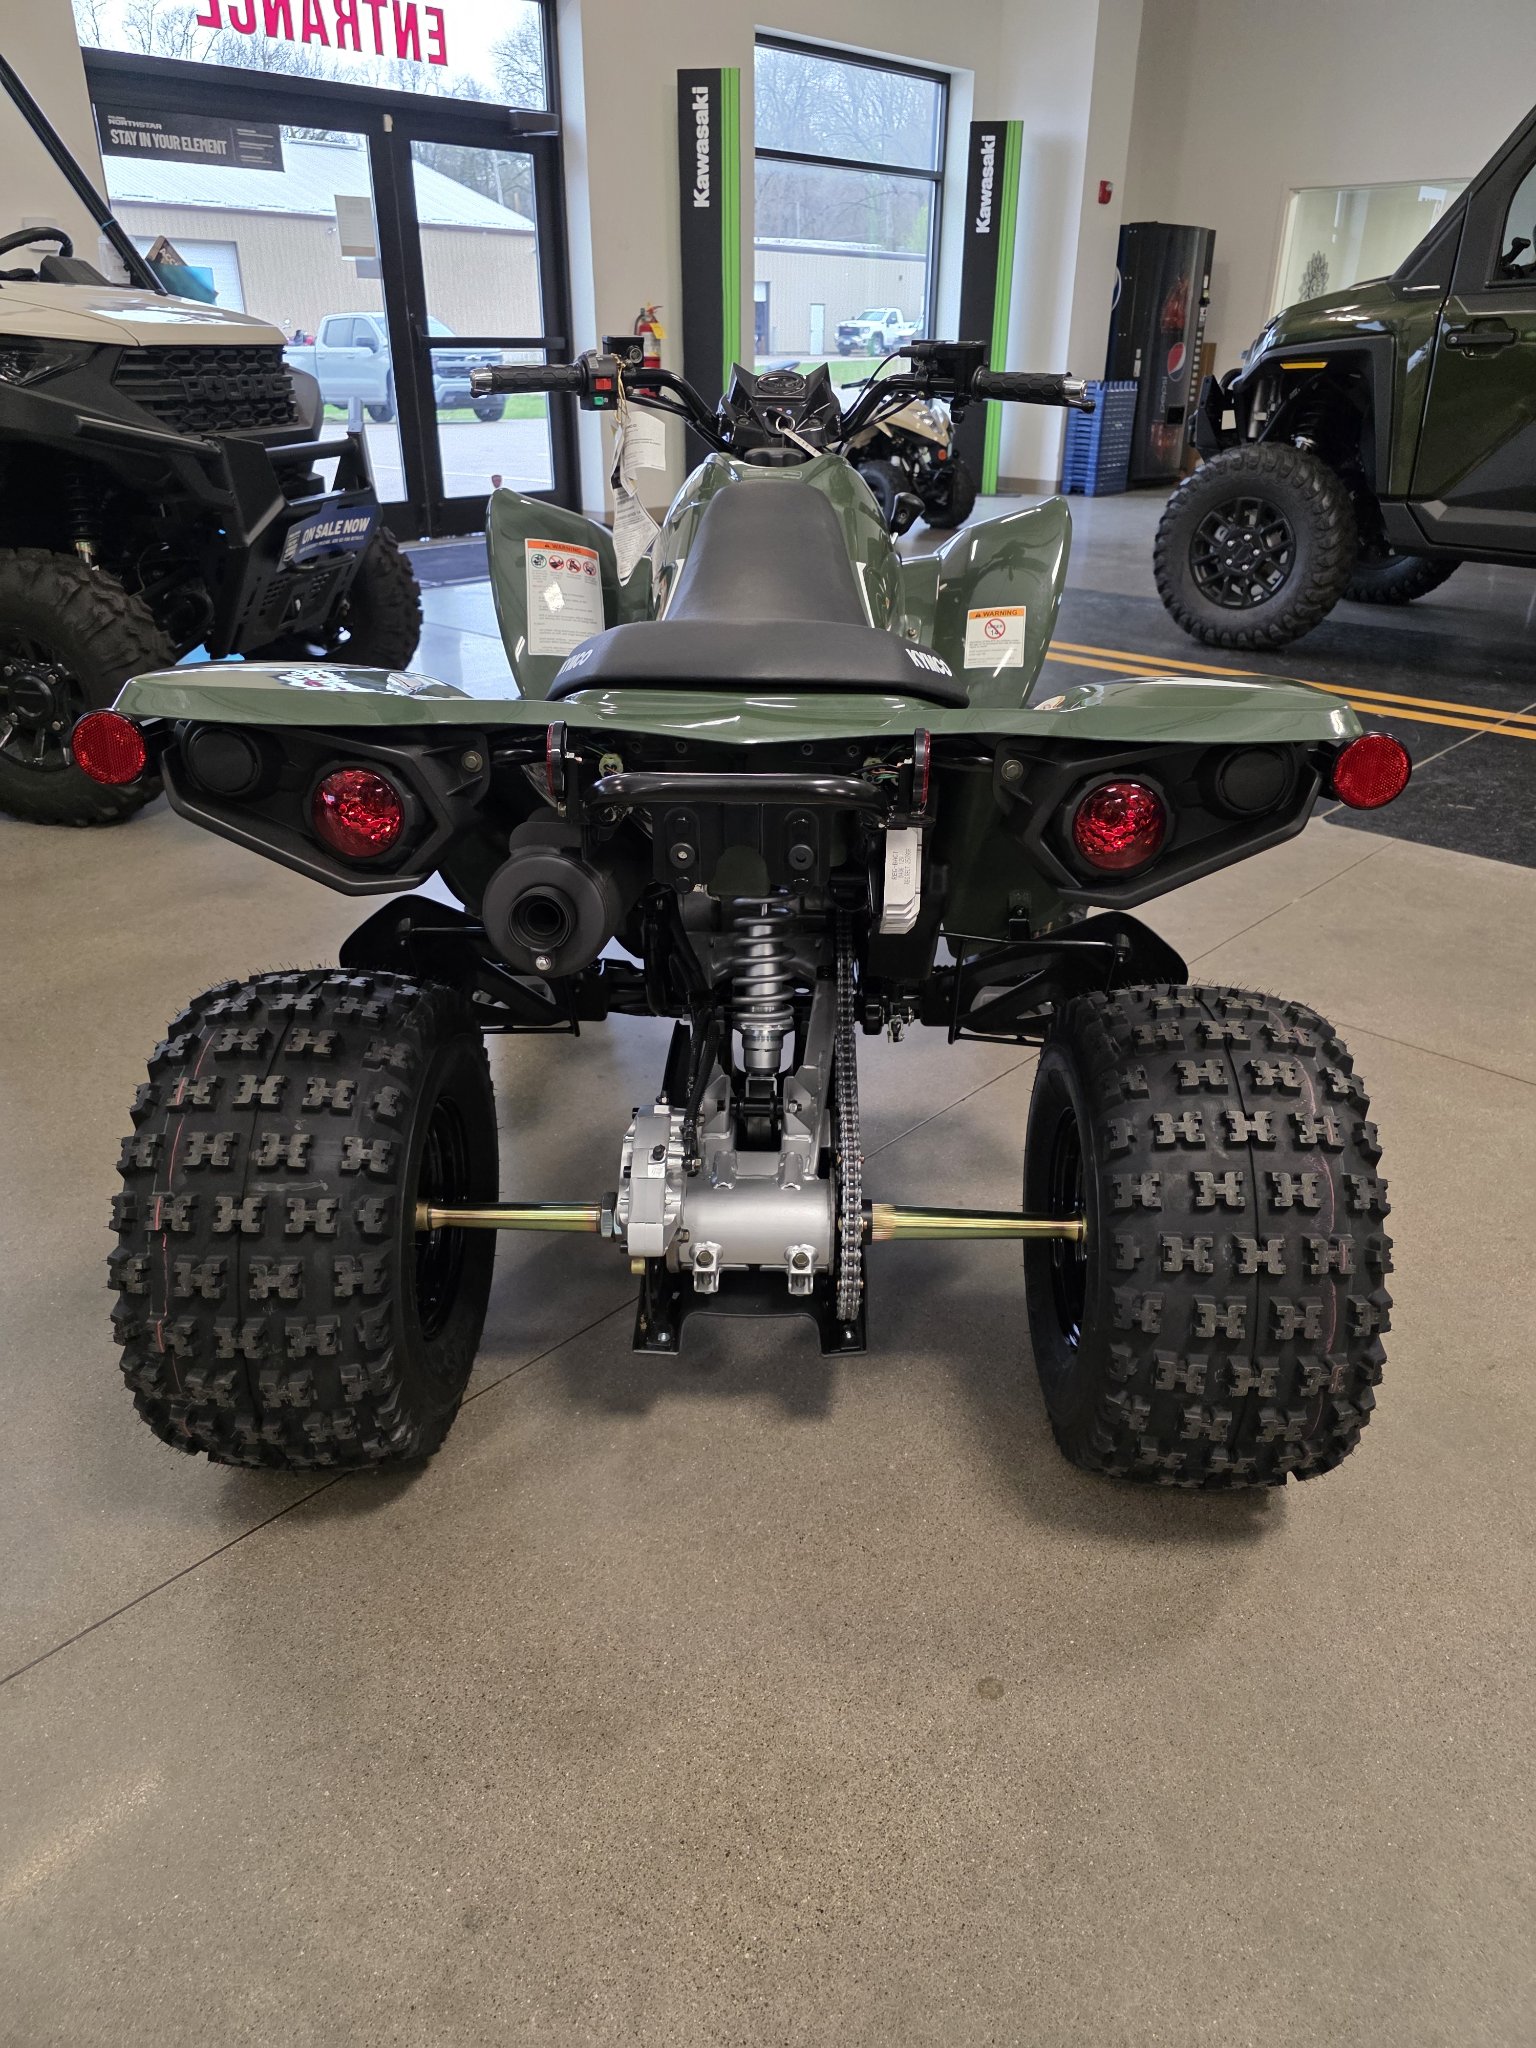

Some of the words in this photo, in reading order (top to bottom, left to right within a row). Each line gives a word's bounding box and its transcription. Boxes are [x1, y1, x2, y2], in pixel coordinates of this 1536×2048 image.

[110, 129, 137, 145] STAY
[139, 132, 151, 148] IN
[153, 133, 181, 151] YOUR
[181, 136, 227, 155] ELEMENT
[692, 86, 710, 208] Kawasaki
[976, 135, 996, 233] Kawasaki
[302, 526, 316, 544] ON
[315, 520, 344, 539] SALE
[343, 517, 370, 534] NOW
[983, 609, 1018, 617] WARNING
[905, 648, 953, 677] KYMCO
